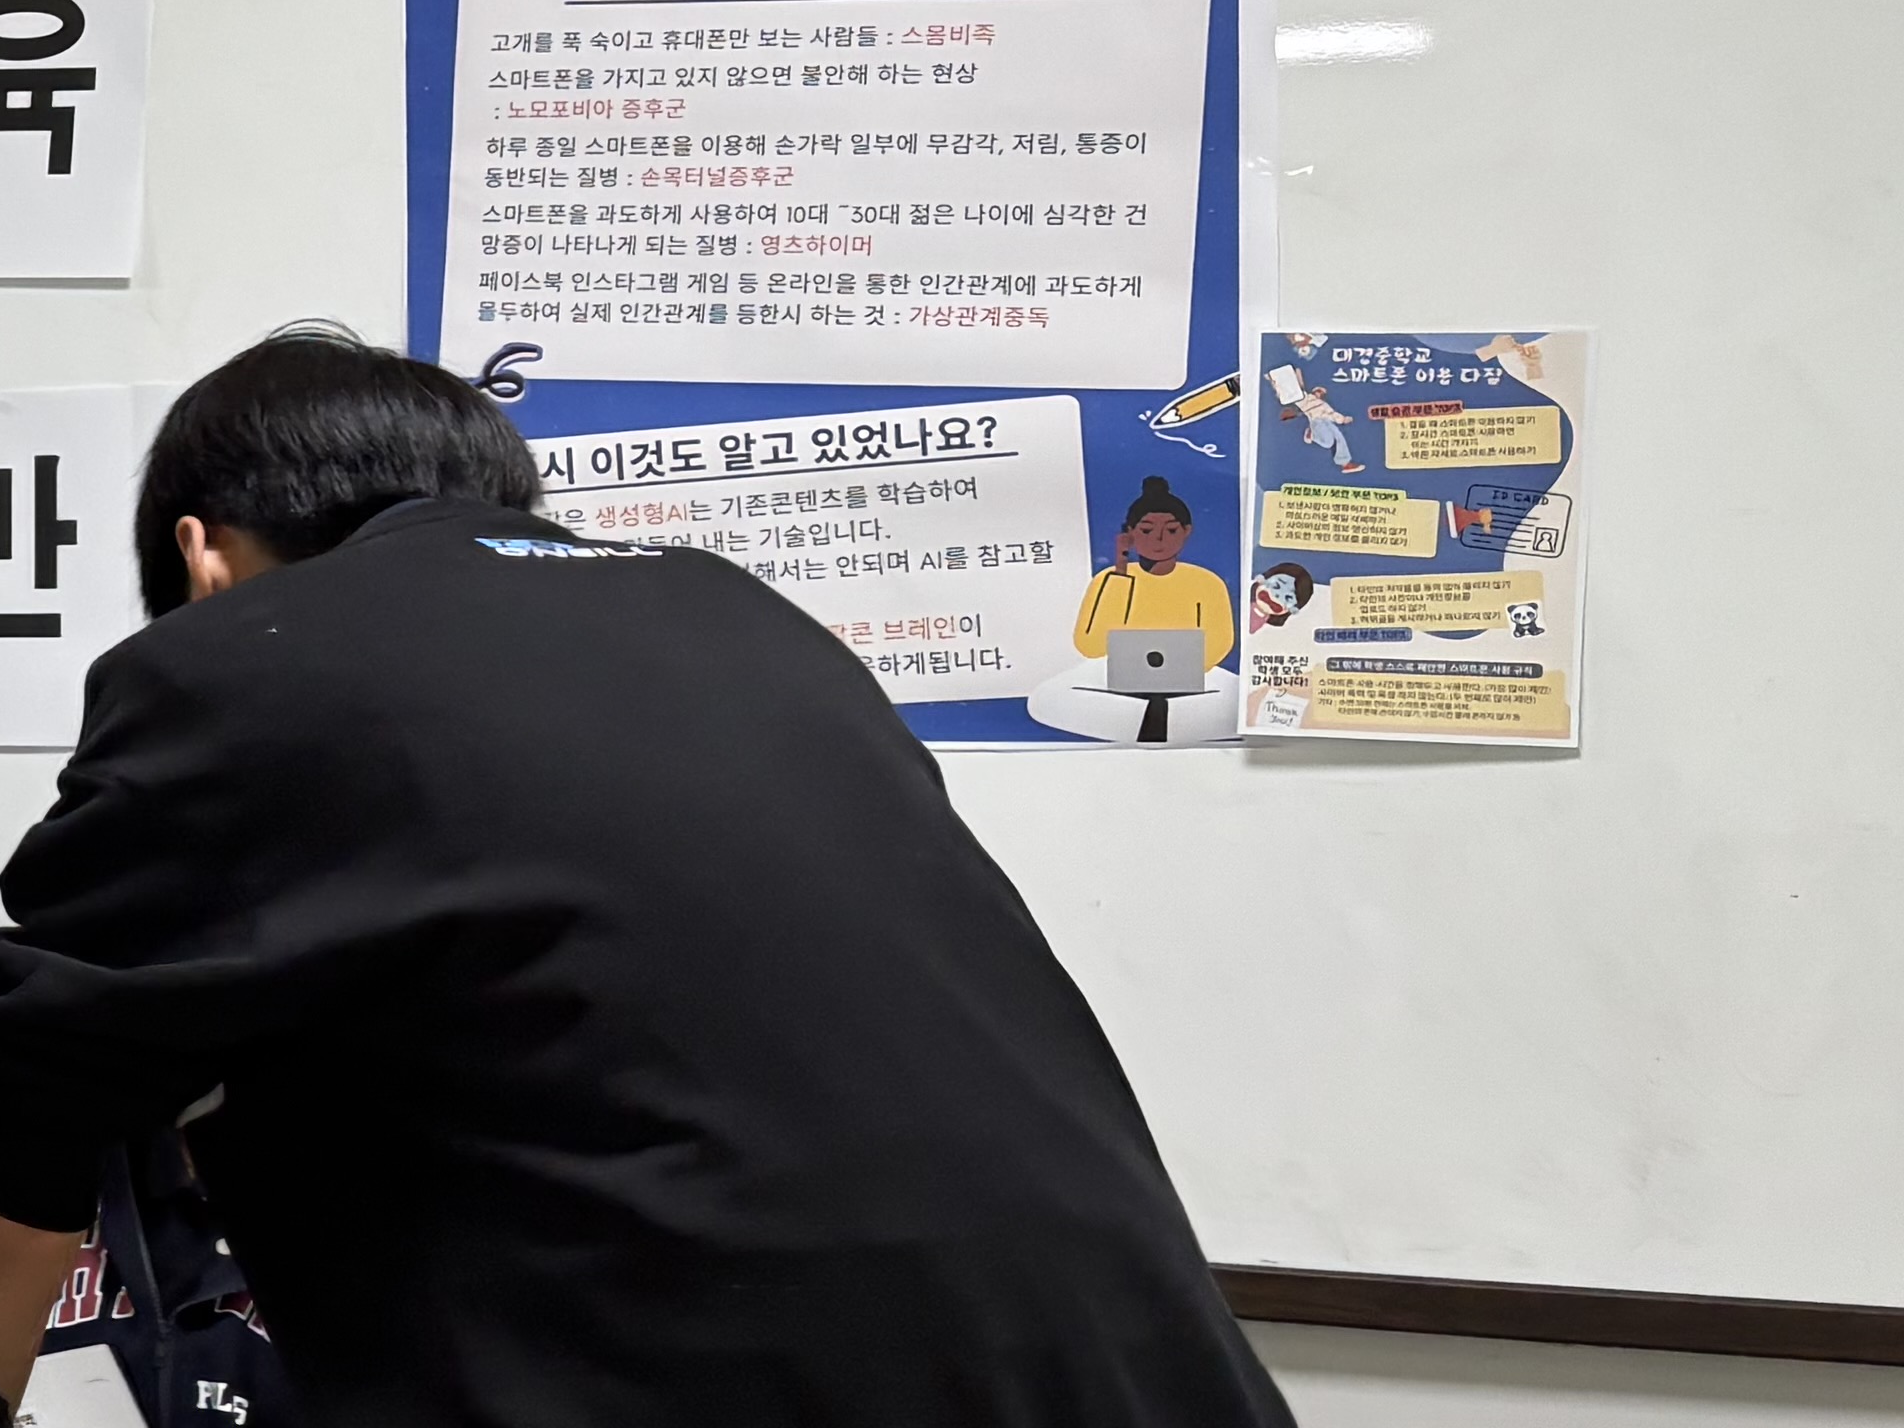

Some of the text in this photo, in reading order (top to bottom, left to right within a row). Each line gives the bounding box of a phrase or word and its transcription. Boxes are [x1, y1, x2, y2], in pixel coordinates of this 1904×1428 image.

[491, 23, 996, 53] 고개를 푹 숙이고 휴대폰만 보는 사람들 스몸비족
[487, 62, 978, 91] 스마트폰을 가지고 있지 않으면 불안해 하는 현상
[507, 98, 687, 120] 노모포비아 증후군
[486, 132, 1147, 158] 하루 종일 스마트폰을 이용해 손가락 일부에 무감각, 저림, 통증이
[484, 166, 794, 189] 동반되는 질병 손목터널증후군
[481, 203, 588, 225] 스마트폰을
[597, 203, 682, 225] 과도하게
[690, 203, 777, 224] 사용하여
[786, 203, 828, 224] 10대
[908, 203, 955, 226] 젊은
[964, 203, 1034, 226] 나이에
[1043, 203, 1116, 226] 심각한
[1125, 203, 1147, 226] 건
[481, 233, 872, 256] 망증이 나타나게 되는 질병 영츠하이머
[479, 271, 1142, 298] 페이스북 인스타그램 게임 등 온라인을 통한 인간관계에 과도하게
[570, 301, 612, 323] 실제
[619, 301, 728, 325] 인간관계를
[736, 302, 802, 326] 등한시
[810, 303, 856, 326] 하는
[864, 304, 887, 326] 것
[909, 305, 1050, 328] 가상관계중독
[1332, 346, 1432, 365] 대경중학교
[1331, 367, 1408, 385] 스마트폰
[1460, 366, 1503, 385] 다짐
[542, 415, 998, 485] 시 이것도 알고 있었나요?
[595, 499, 712, 529] 생성형AI는
[720, 484, 869, 519] 기존콘텐츠를
[876, 476, 978, 506] 학습하여
[702, 530, 750, 553] 내는
[759, 518, 892, 549] 기술입니다.
[744, 540, 1054, 582] 해서는 안되며 AI를 참고할
[883, 613, 981, 641] 브레인이
